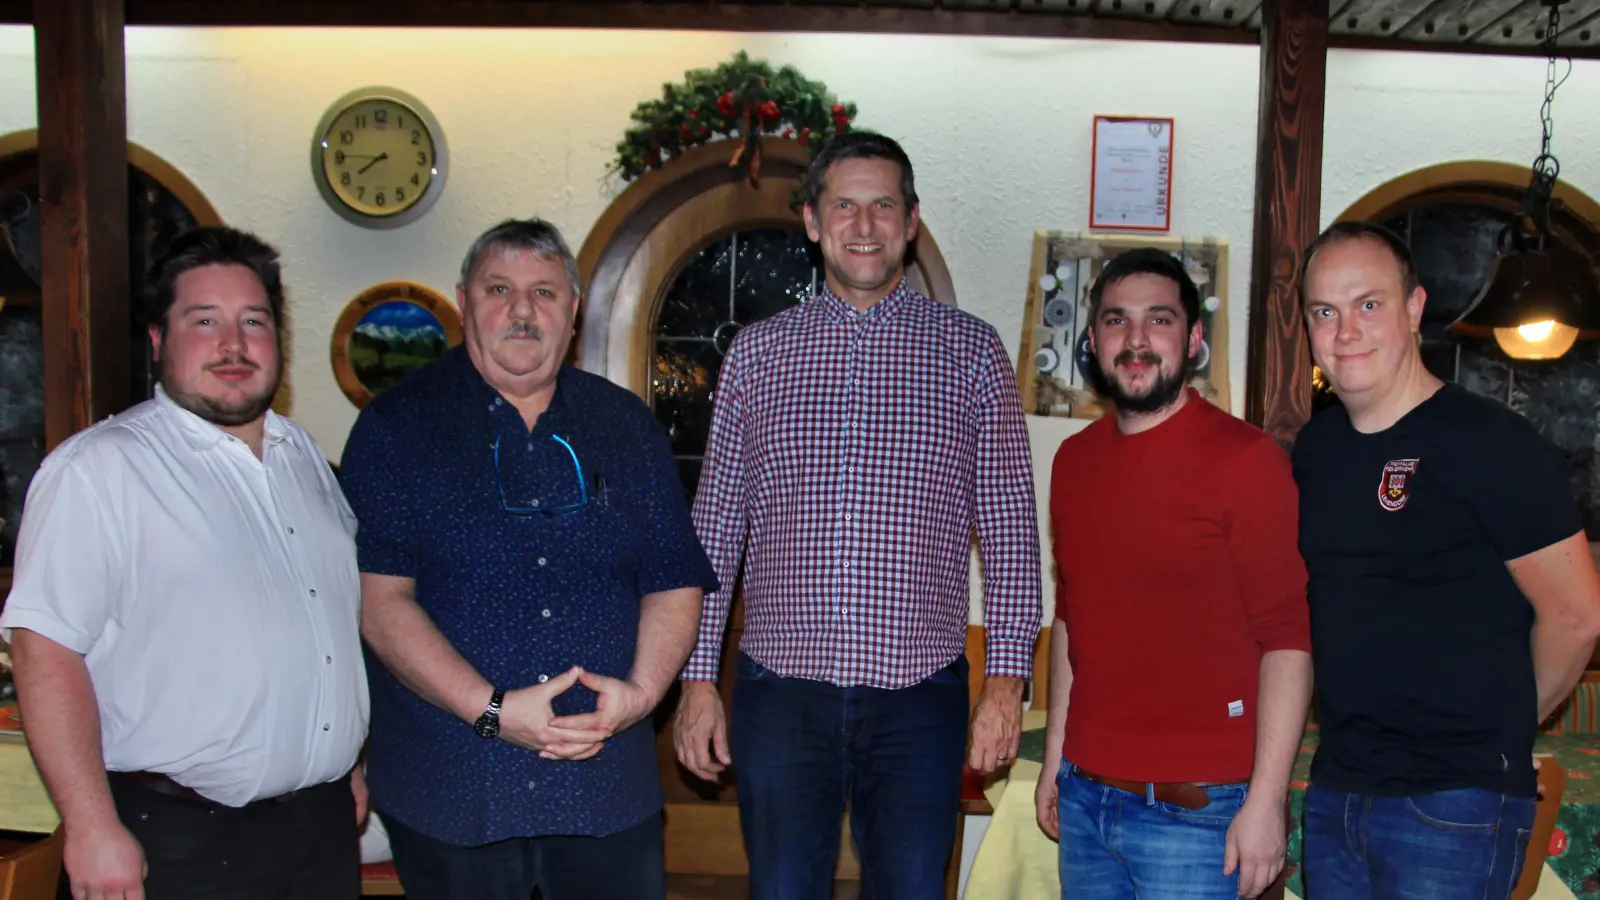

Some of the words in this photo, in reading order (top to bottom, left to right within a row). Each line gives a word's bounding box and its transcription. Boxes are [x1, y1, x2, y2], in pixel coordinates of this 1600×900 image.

[355, 115, 367, 129] 11
[374, 109, 387, 123] 12
[340, 130, 354, 145] 10
[411, 130, 420, 144] 2
[334, 150, 345, 164] 9
[417, 151, 427, 166] 3
[341, 172, 351, 186] 8
[410, 173, 420, 187] 4
[1156, 145, 1169, 217] URKUNDE
[356, 186, 365, 200] 7
[375, 191, 386, 206] 6
[395, 187, 405, 202] 5
